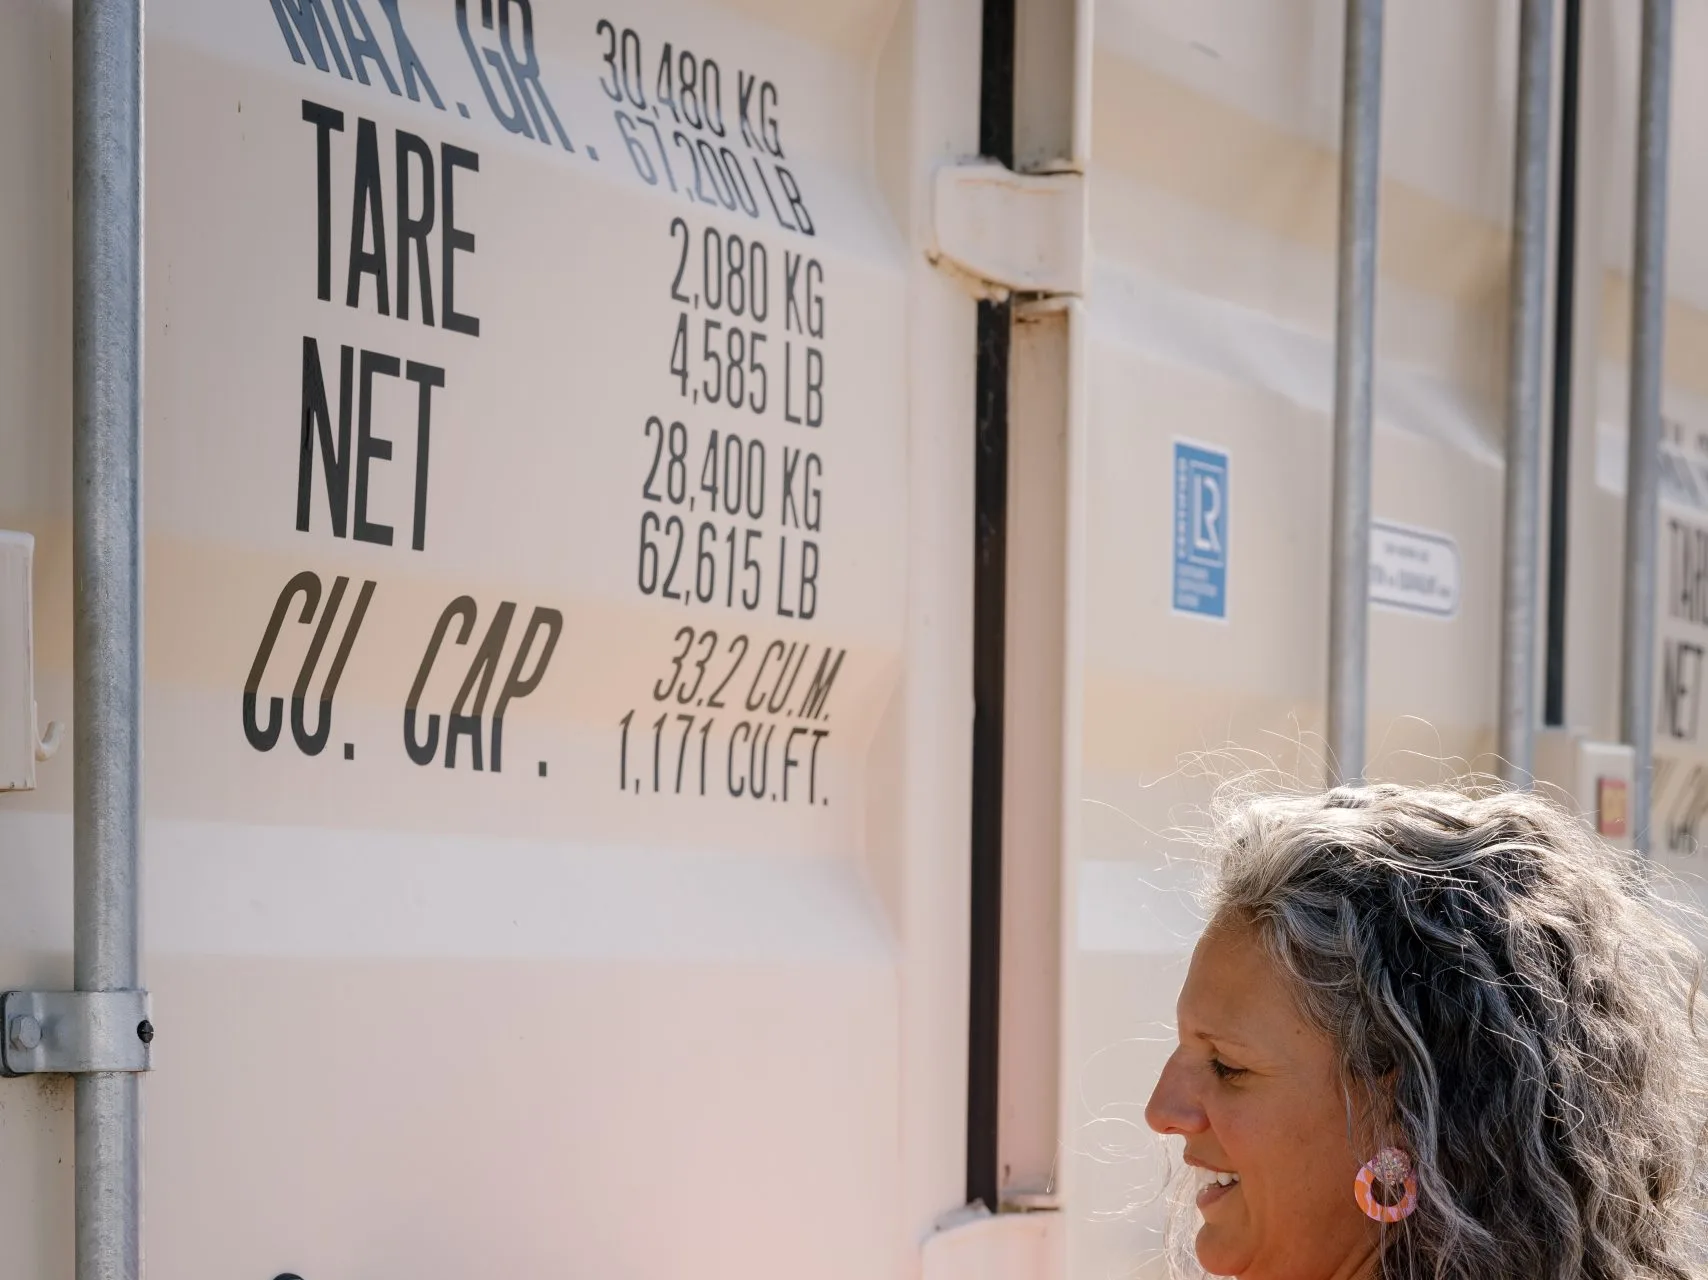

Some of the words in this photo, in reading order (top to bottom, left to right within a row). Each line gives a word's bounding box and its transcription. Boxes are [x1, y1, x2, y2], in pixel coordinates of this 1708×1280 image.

[596, 19, 726, 137] 30,480
[738, 70, 785, 159] KG
[302, 99, 480, 337] TARE
[614, 110, 760, 219] 67,200
[752, 157, 815, 236] LB
[670, 217, 768, 323] 2,080
[784, 249, 824, 339] KG
[670, 312, 768, 415] 4,585
[784, 341, 824, 428] LB
[296, 336, 445, 552] NET
[642, 416, 766, 520] 28,400
[781, 446, 823, 532] KG
[638, 511, 763, 611] 62,615
[777, 536, 820, 620] LB
[242, 571, 378, 760] CU.
[403, 595, 564, 777] CAP.
[653, 625, 750, 709] 33.2
[745, 640, 846, 721] CU.M.
[619, 709, 715, 797] 1,171
[728, 721, 830, 806] CU.FT.
